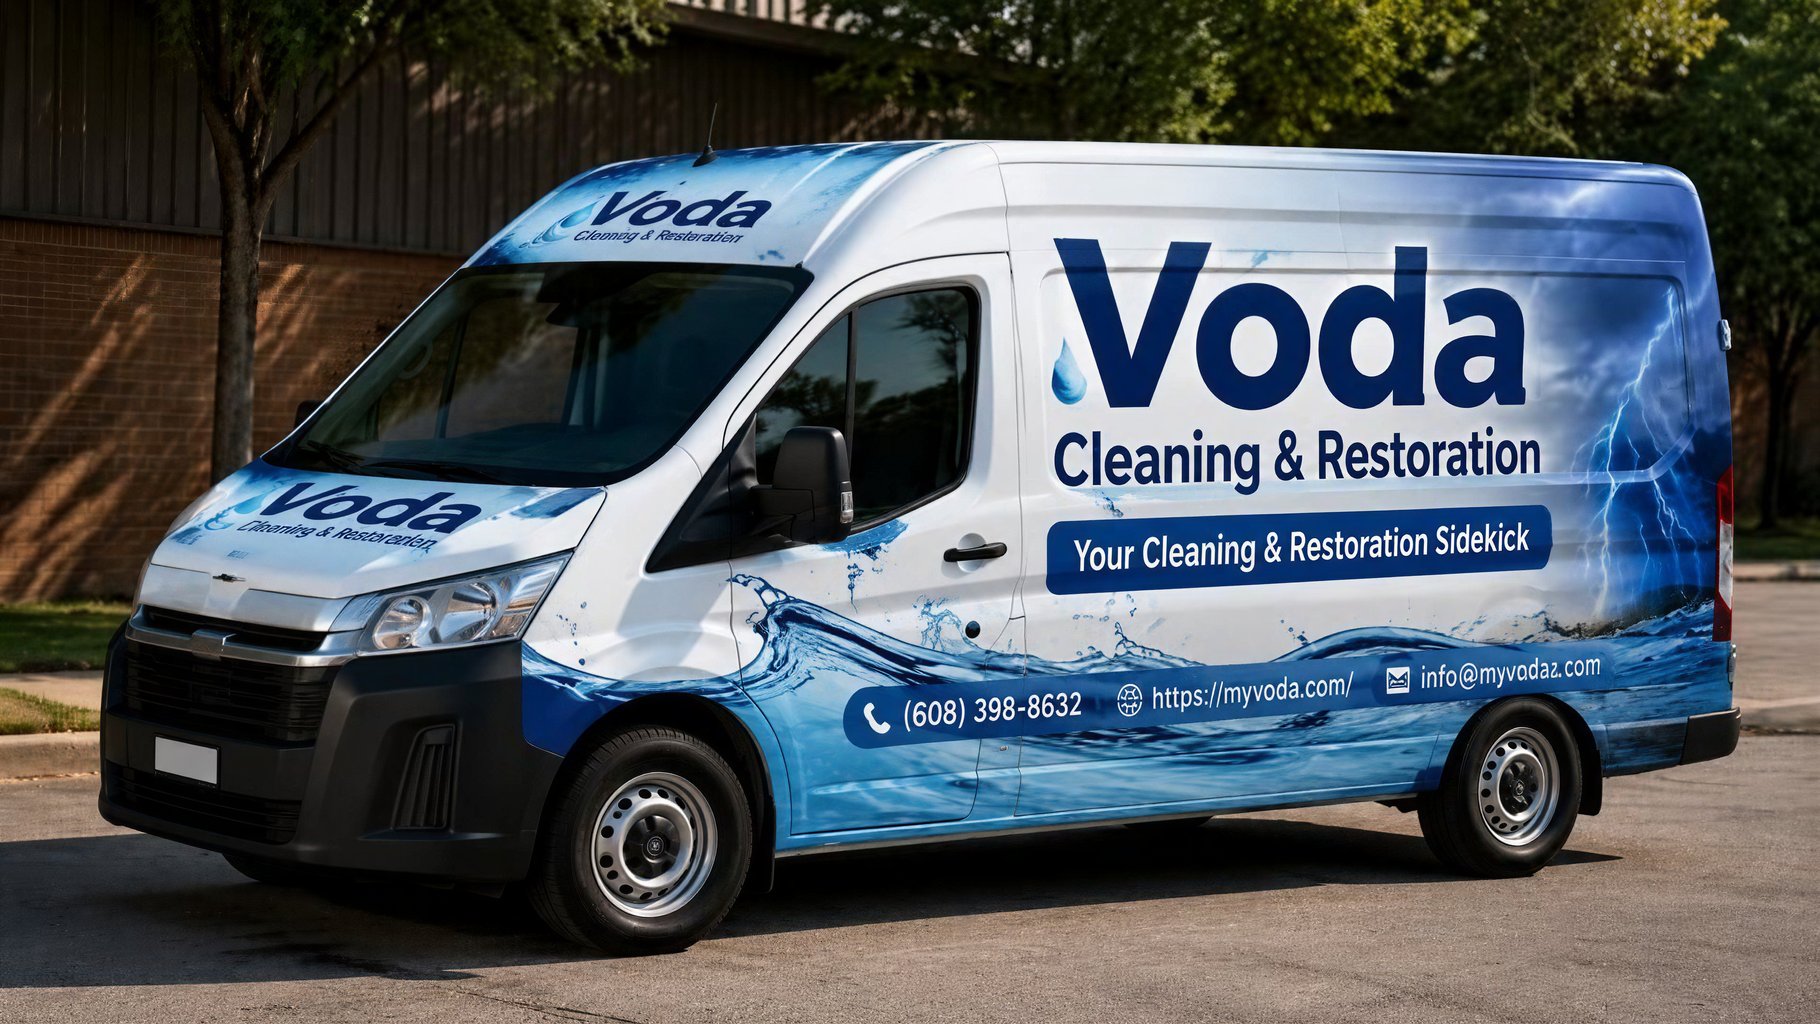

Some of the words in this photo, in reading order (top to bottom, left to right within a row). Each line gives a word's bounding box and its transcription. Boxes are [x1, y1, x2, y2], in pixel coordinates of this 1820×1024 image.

[590, 190, 772, 228] Voda
[639, 229, 655, 241] &
[1053, 237, 1527, 411] Voda
[1053, 428, 1261, 496] Cleaning
[1274, 429, 1305, 482] &
[1318, 425, 1542, 480] Restoration
[259, 482, 483, 534] Voda
[315, 526, 335, 537] &
[1073, 538, 1135, 573] Your
[1142, 533, 1256, 574] Cleaning
[1263, 531, 1282, 564] &
[1290, 526, 1428, 562] Restoration
[1435, 522, 1530, 556] Sidekick
[903, 697, 967, 732] (608)
[973, 691, 1082, 724] 398-8632
[1152, 670, 1355, 713] https://myvoda.com/
